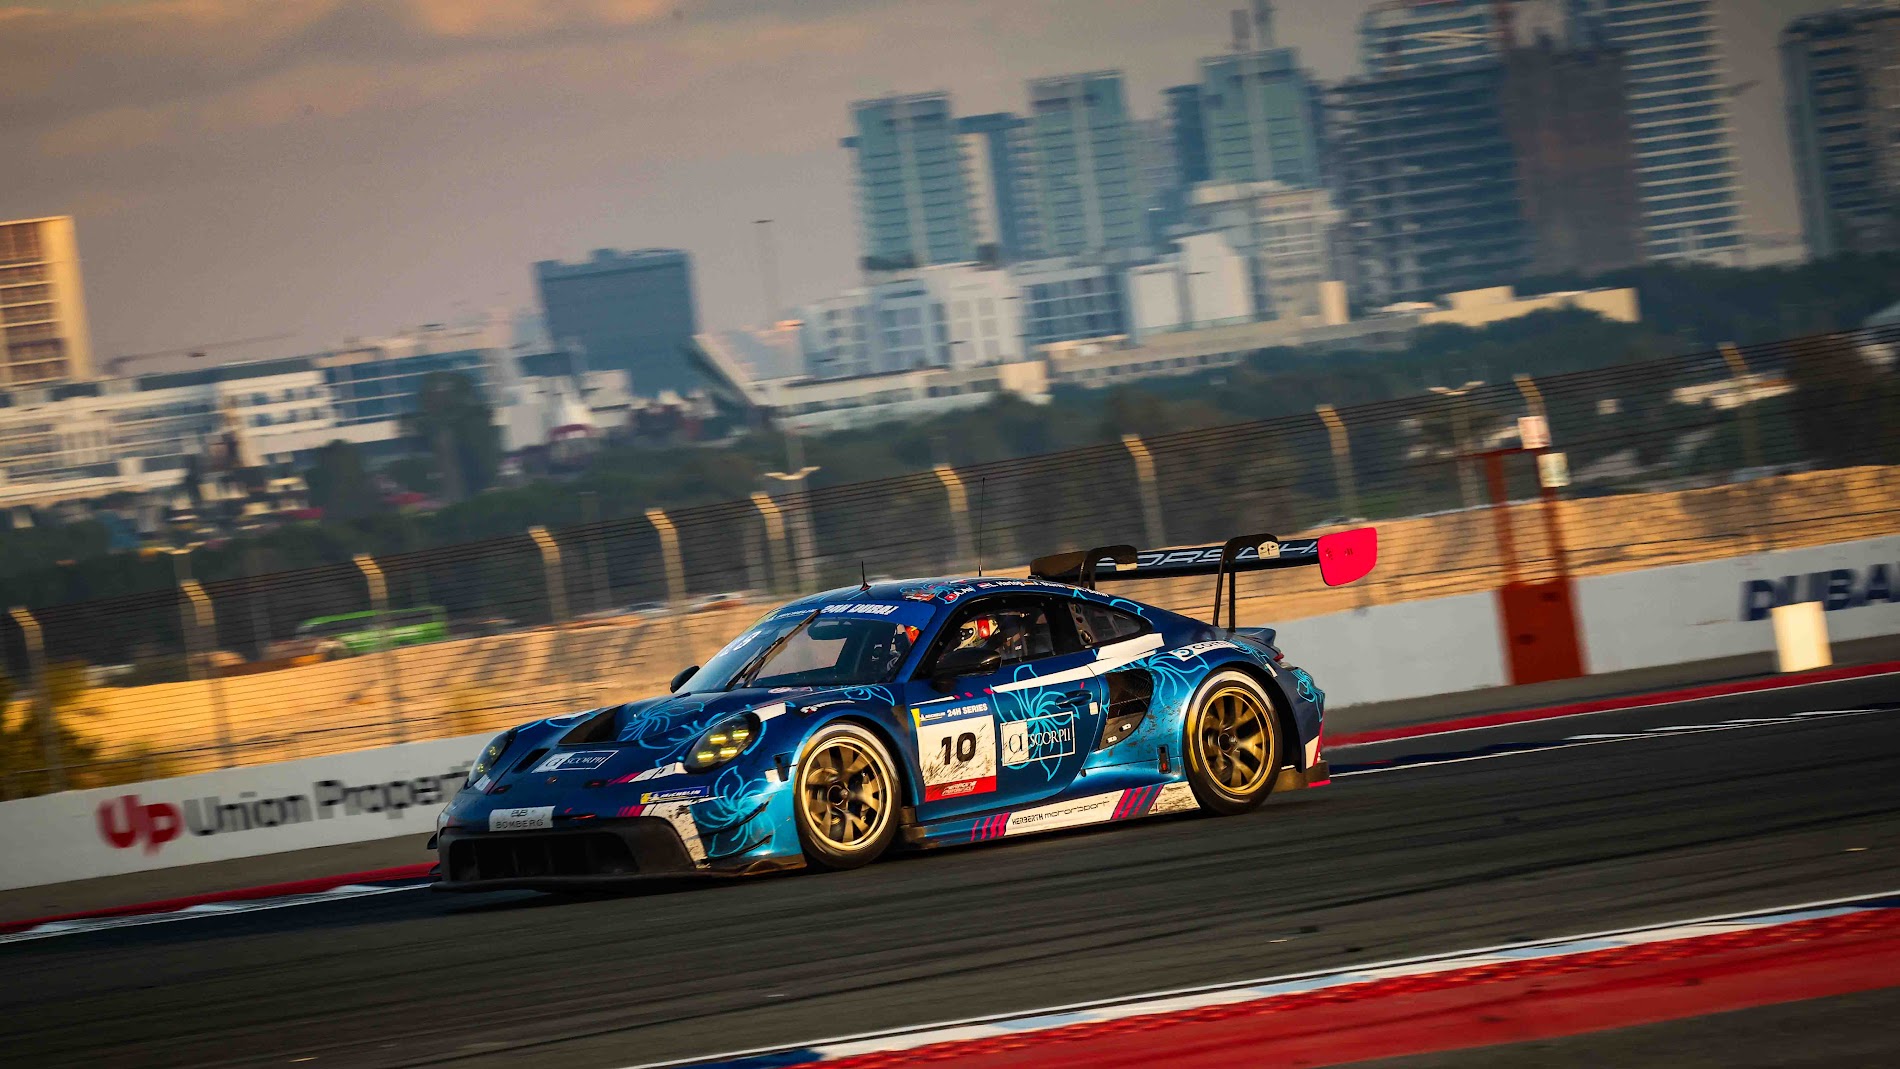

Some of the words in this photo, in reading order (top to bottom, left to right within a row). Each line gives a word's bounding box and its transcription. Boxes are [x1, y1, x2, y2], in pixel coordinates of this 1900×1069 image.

[1740, 561, 1900, 621] DUBA
[946, 707, 962, 718] 24H
[962, 703, 988, 715] SERIES
[941, 731, 977, 766] 10
[1029, 728, 1071, 748] SCORPII
[660, 789, 702, 798] MICHELIN
[97, 793, 184, 857] Up
[183, 788, 313, 838] Union
[495, 818, 545, 829] BOMBERG
[1011, 813, 1044, 826] HERBERTH
[1044, 800, 1110, 819] motorsport
